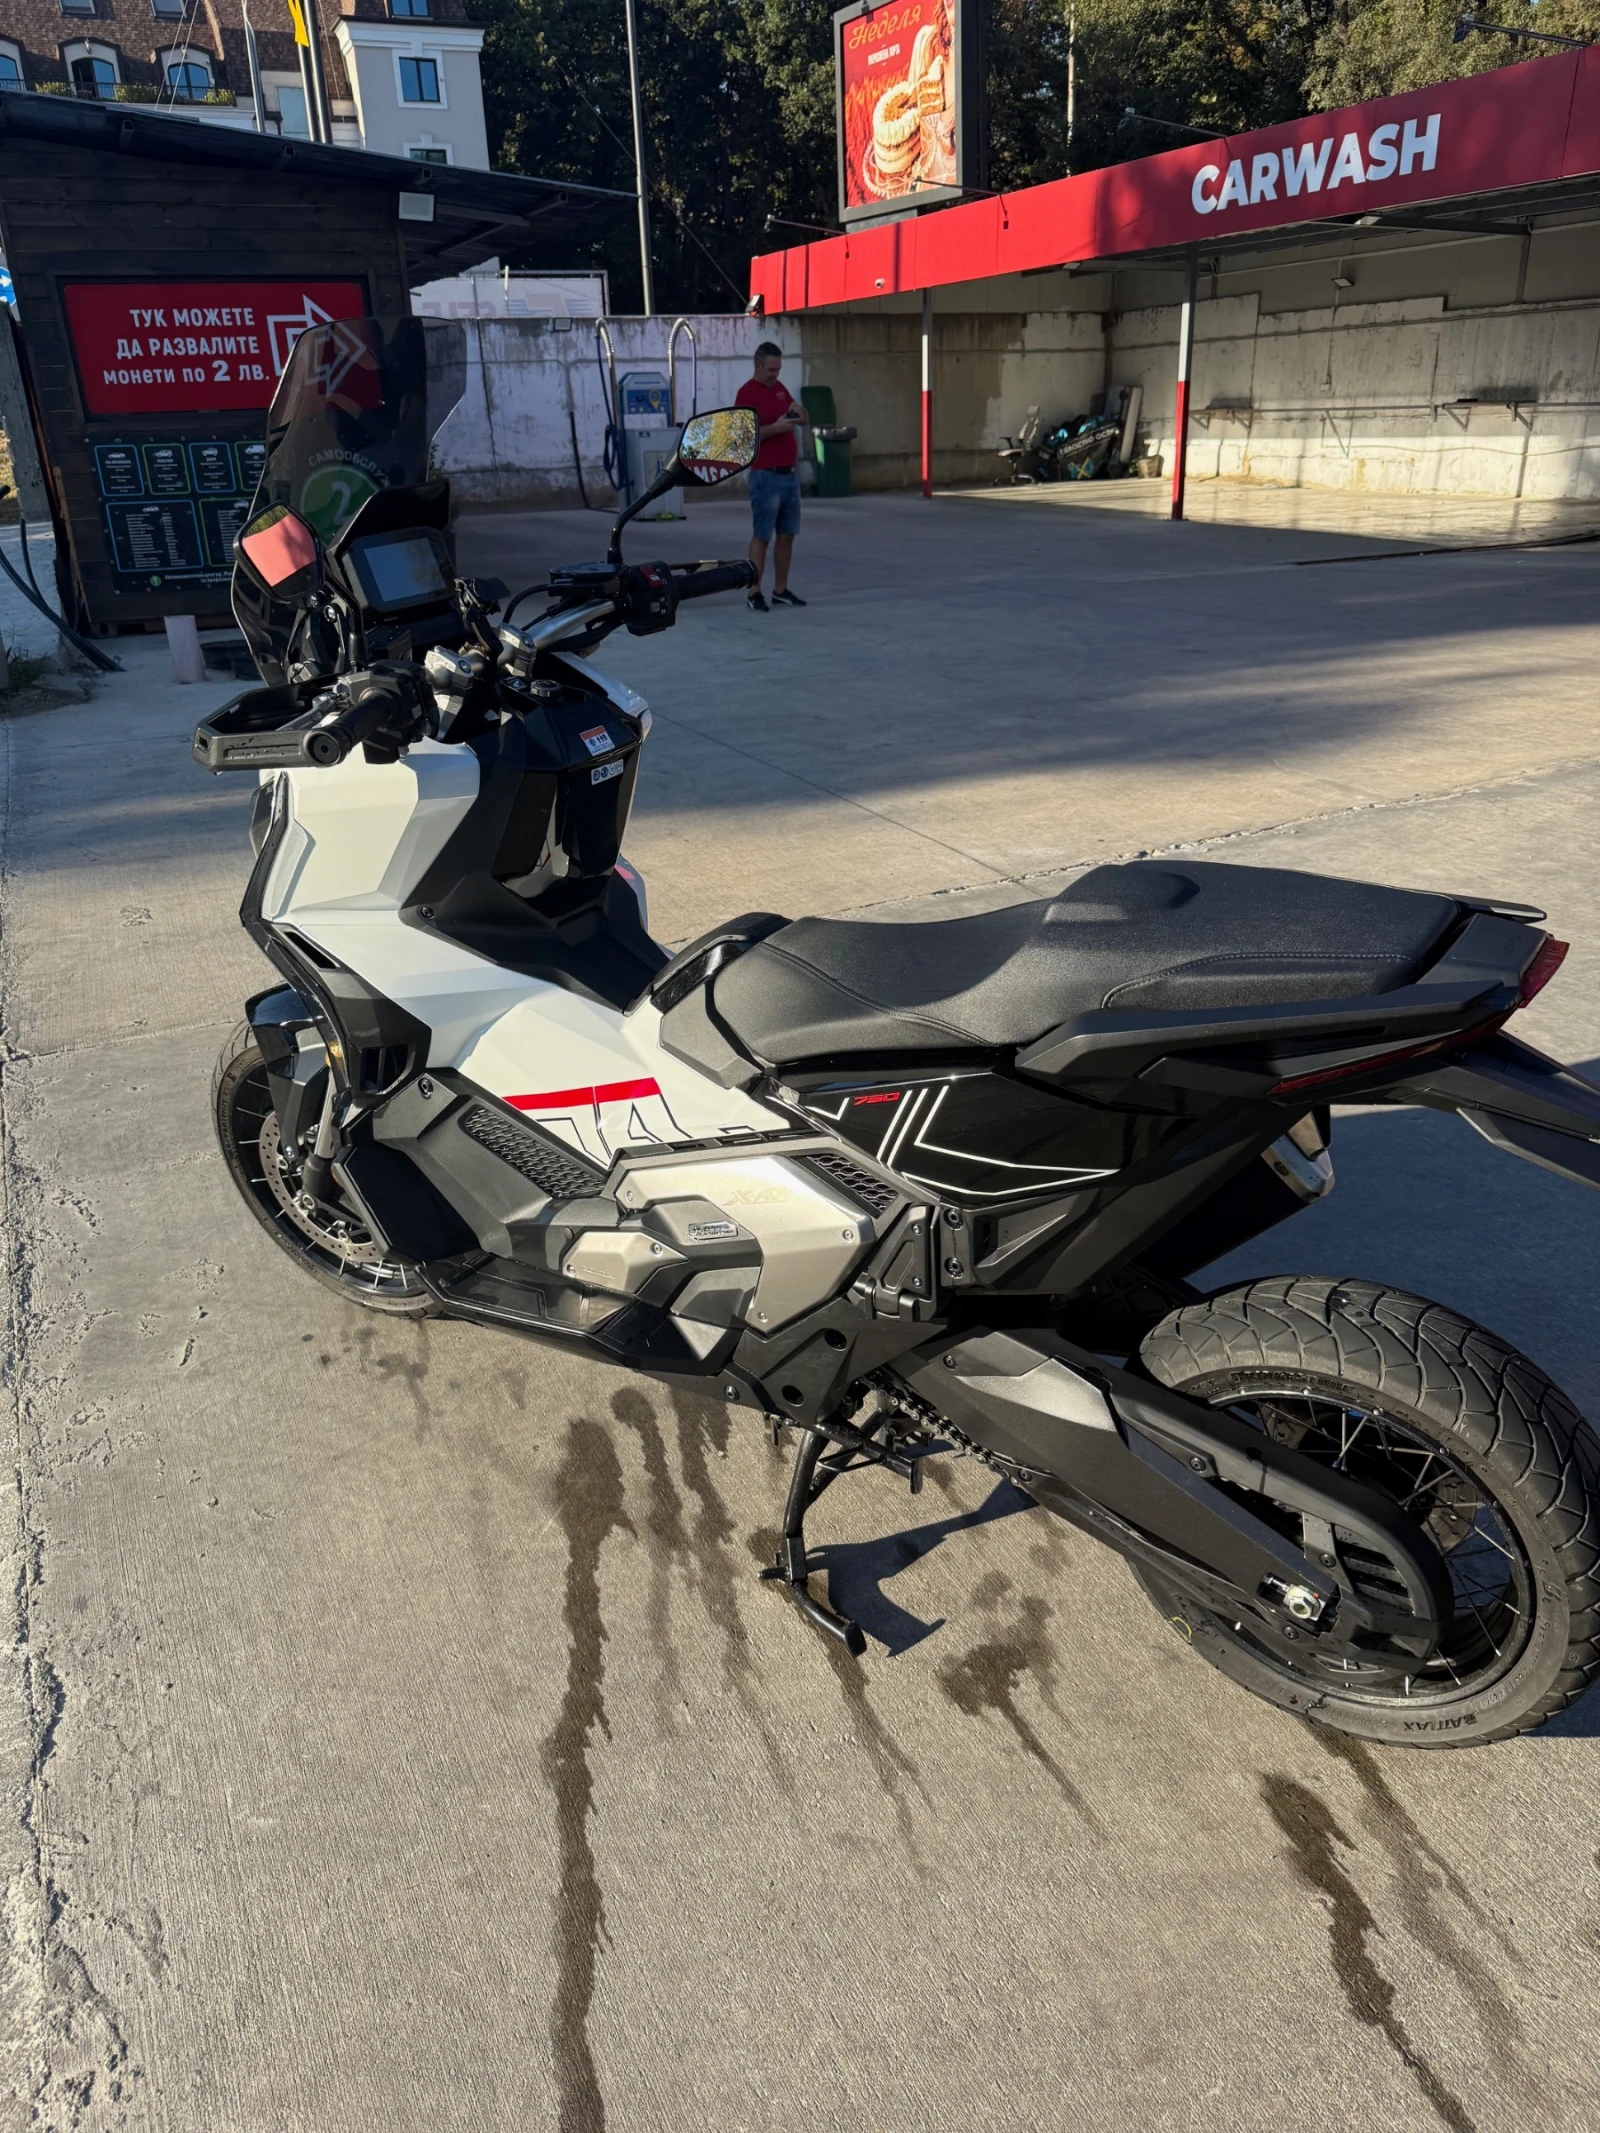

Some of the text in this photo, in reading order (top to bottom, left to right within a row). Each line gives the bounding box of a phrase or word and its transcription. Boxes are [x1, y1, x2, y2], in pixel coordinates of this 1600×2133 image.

[848, 4, 922, 50] Неделя
[1191, 113, 1442, 215] CARWASH
[129, 307, 255, 328] ТУК МОЖЕТЕ
[116, 336, 260, 360] ДА РАЗВАЛИТЕ
[182, 367, 206, 383] по
[211, 359, 231, 382] 2
[331, 481, 352, 526] 2
[853, 1091, 901, 1106] 750
